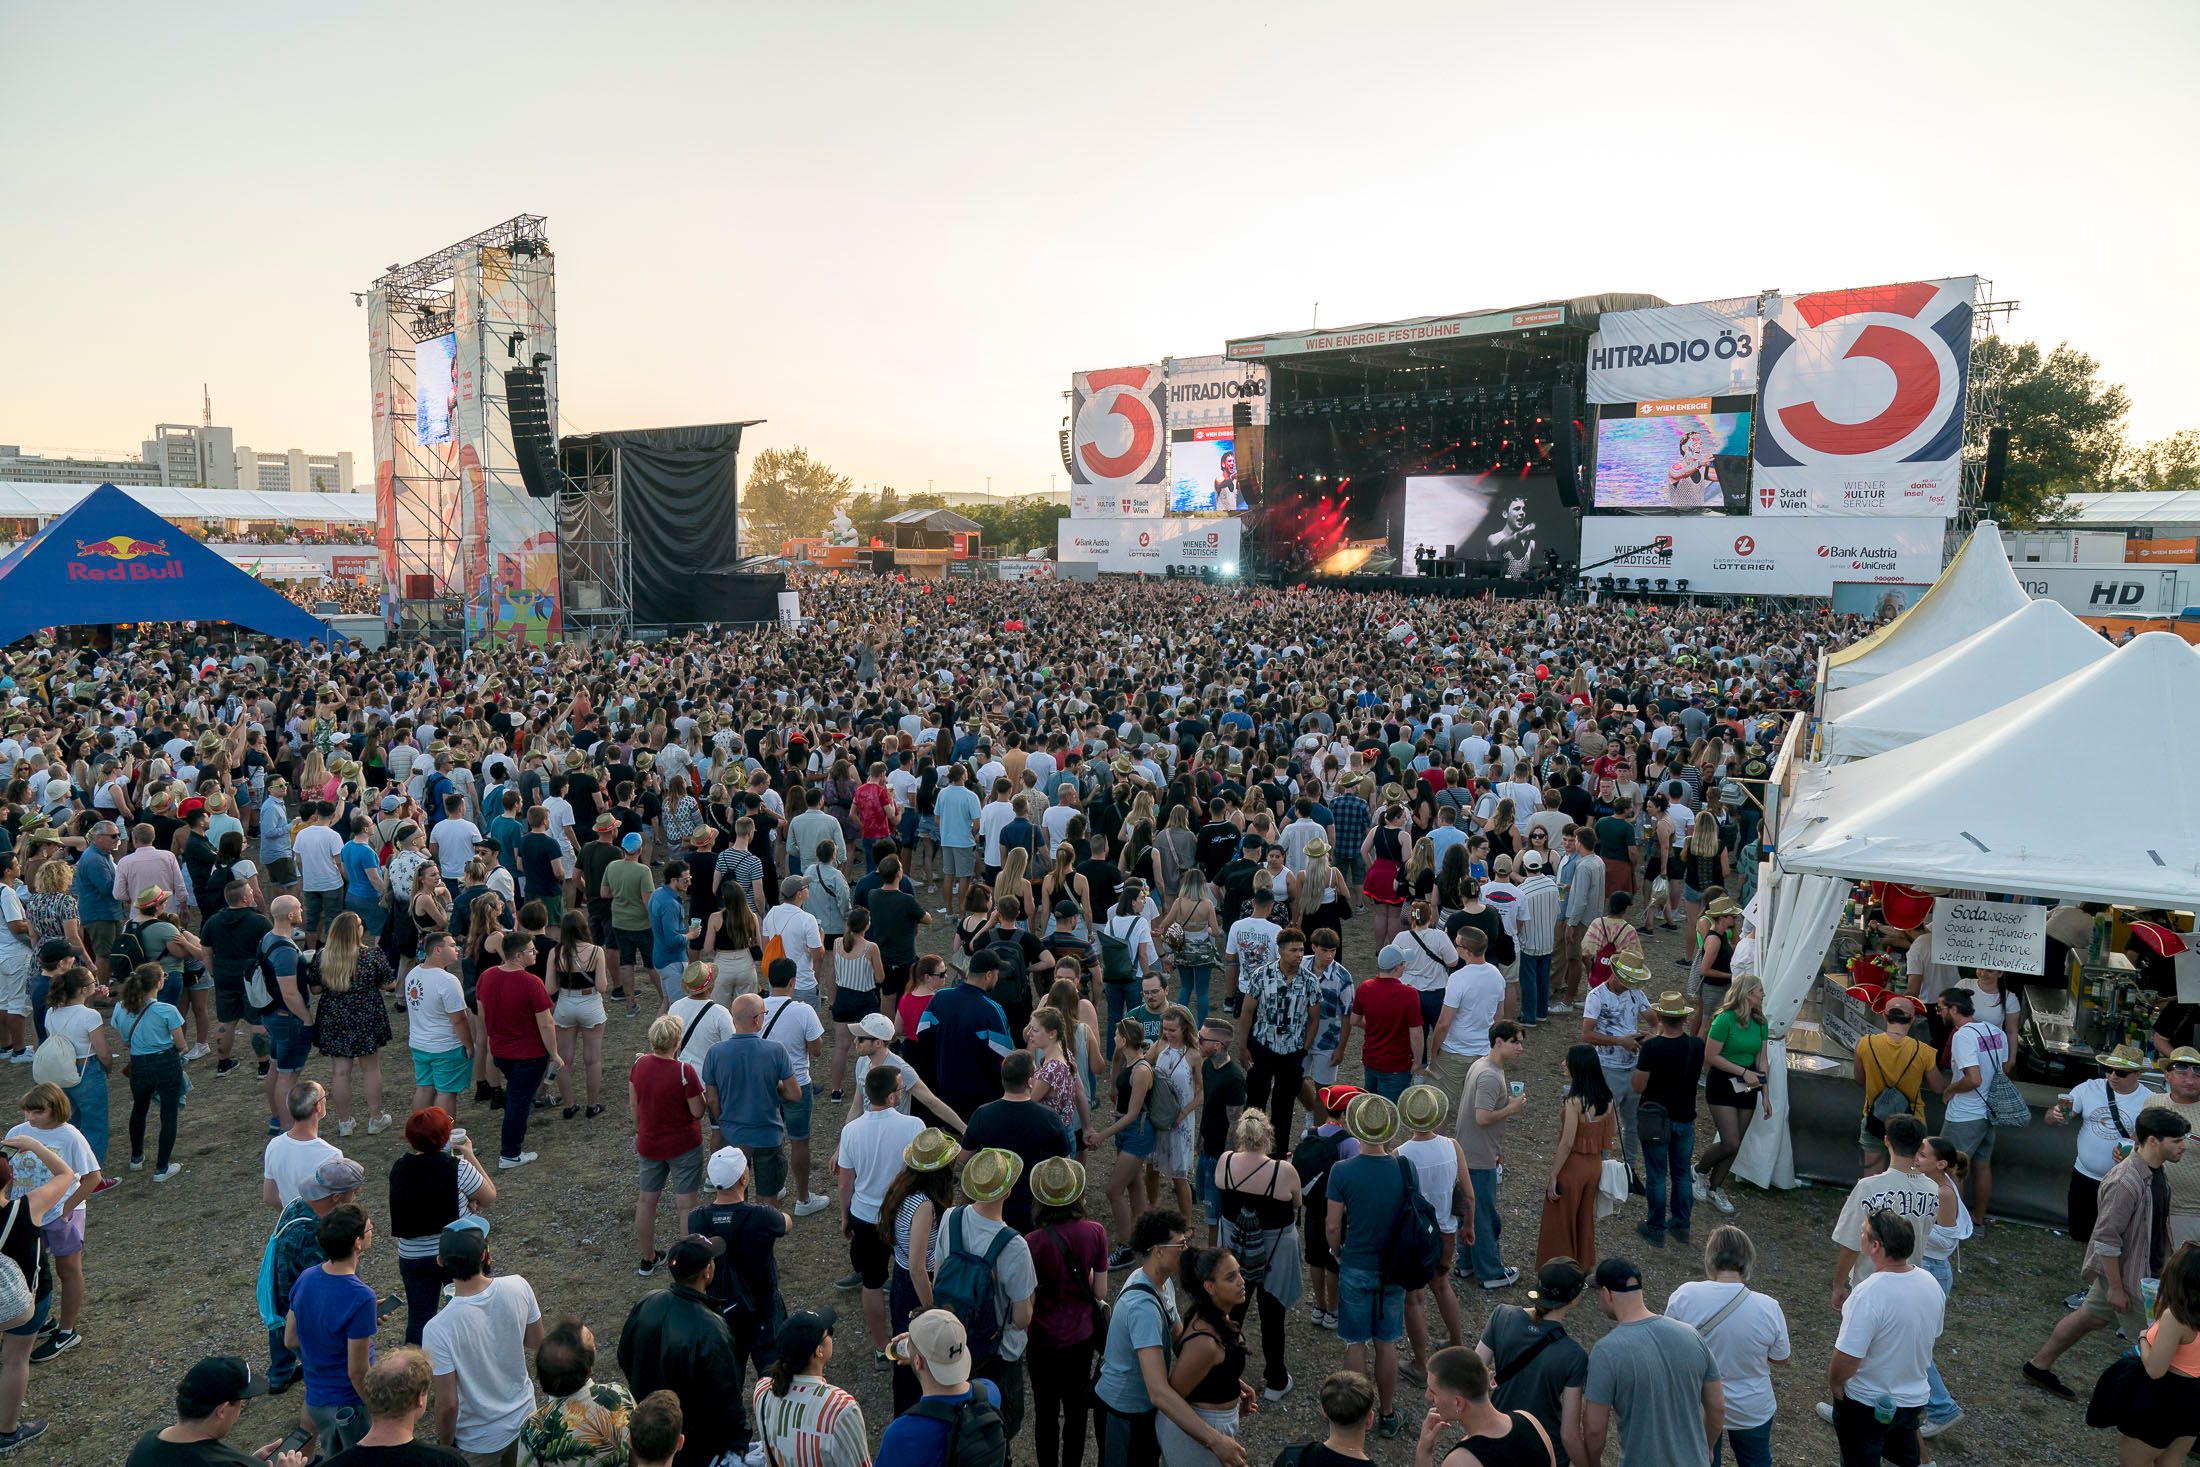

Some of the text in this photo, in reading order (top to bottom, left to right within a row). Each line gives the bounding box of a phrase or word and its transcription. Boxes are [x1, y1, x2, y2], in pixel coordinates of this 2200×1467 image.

[1305, 322, 1461, 350] WIEN ENERGIE FESTBÜHNE
[1591, 329, 1753, 371] HITRADIO Ö3
[1170, 380, 1240, 402] HITRADIO
[1677, 402, 1708, 411] ENERGIE
[1844, 481, 1885, 490] WIENER
[1780, 488, 1807, 498] Stadt
[1844, 490, 1885, 499] KULTUR
[1780, 499, 1807, 509] Wien
[1843, 499, 1885, 508] SERVICE
[1614, 545, 1653, 555] WIENER
[1830, 546, 1897, 558] Bank Austria
[67, 559, 184, 581] Red Bull
[1862, 561, 1896, 571] UniCredit
[2089, 580, 2144, 605] HD
[1951, 904, 2028, 924] Sodawasser
[1945, 920, 1975, 934] Soda
[1947, 934, 1975, 948] Soda
[1988, 937, 2032, 956] Zitrone
[1940, 950, 1975, 964] weitere
